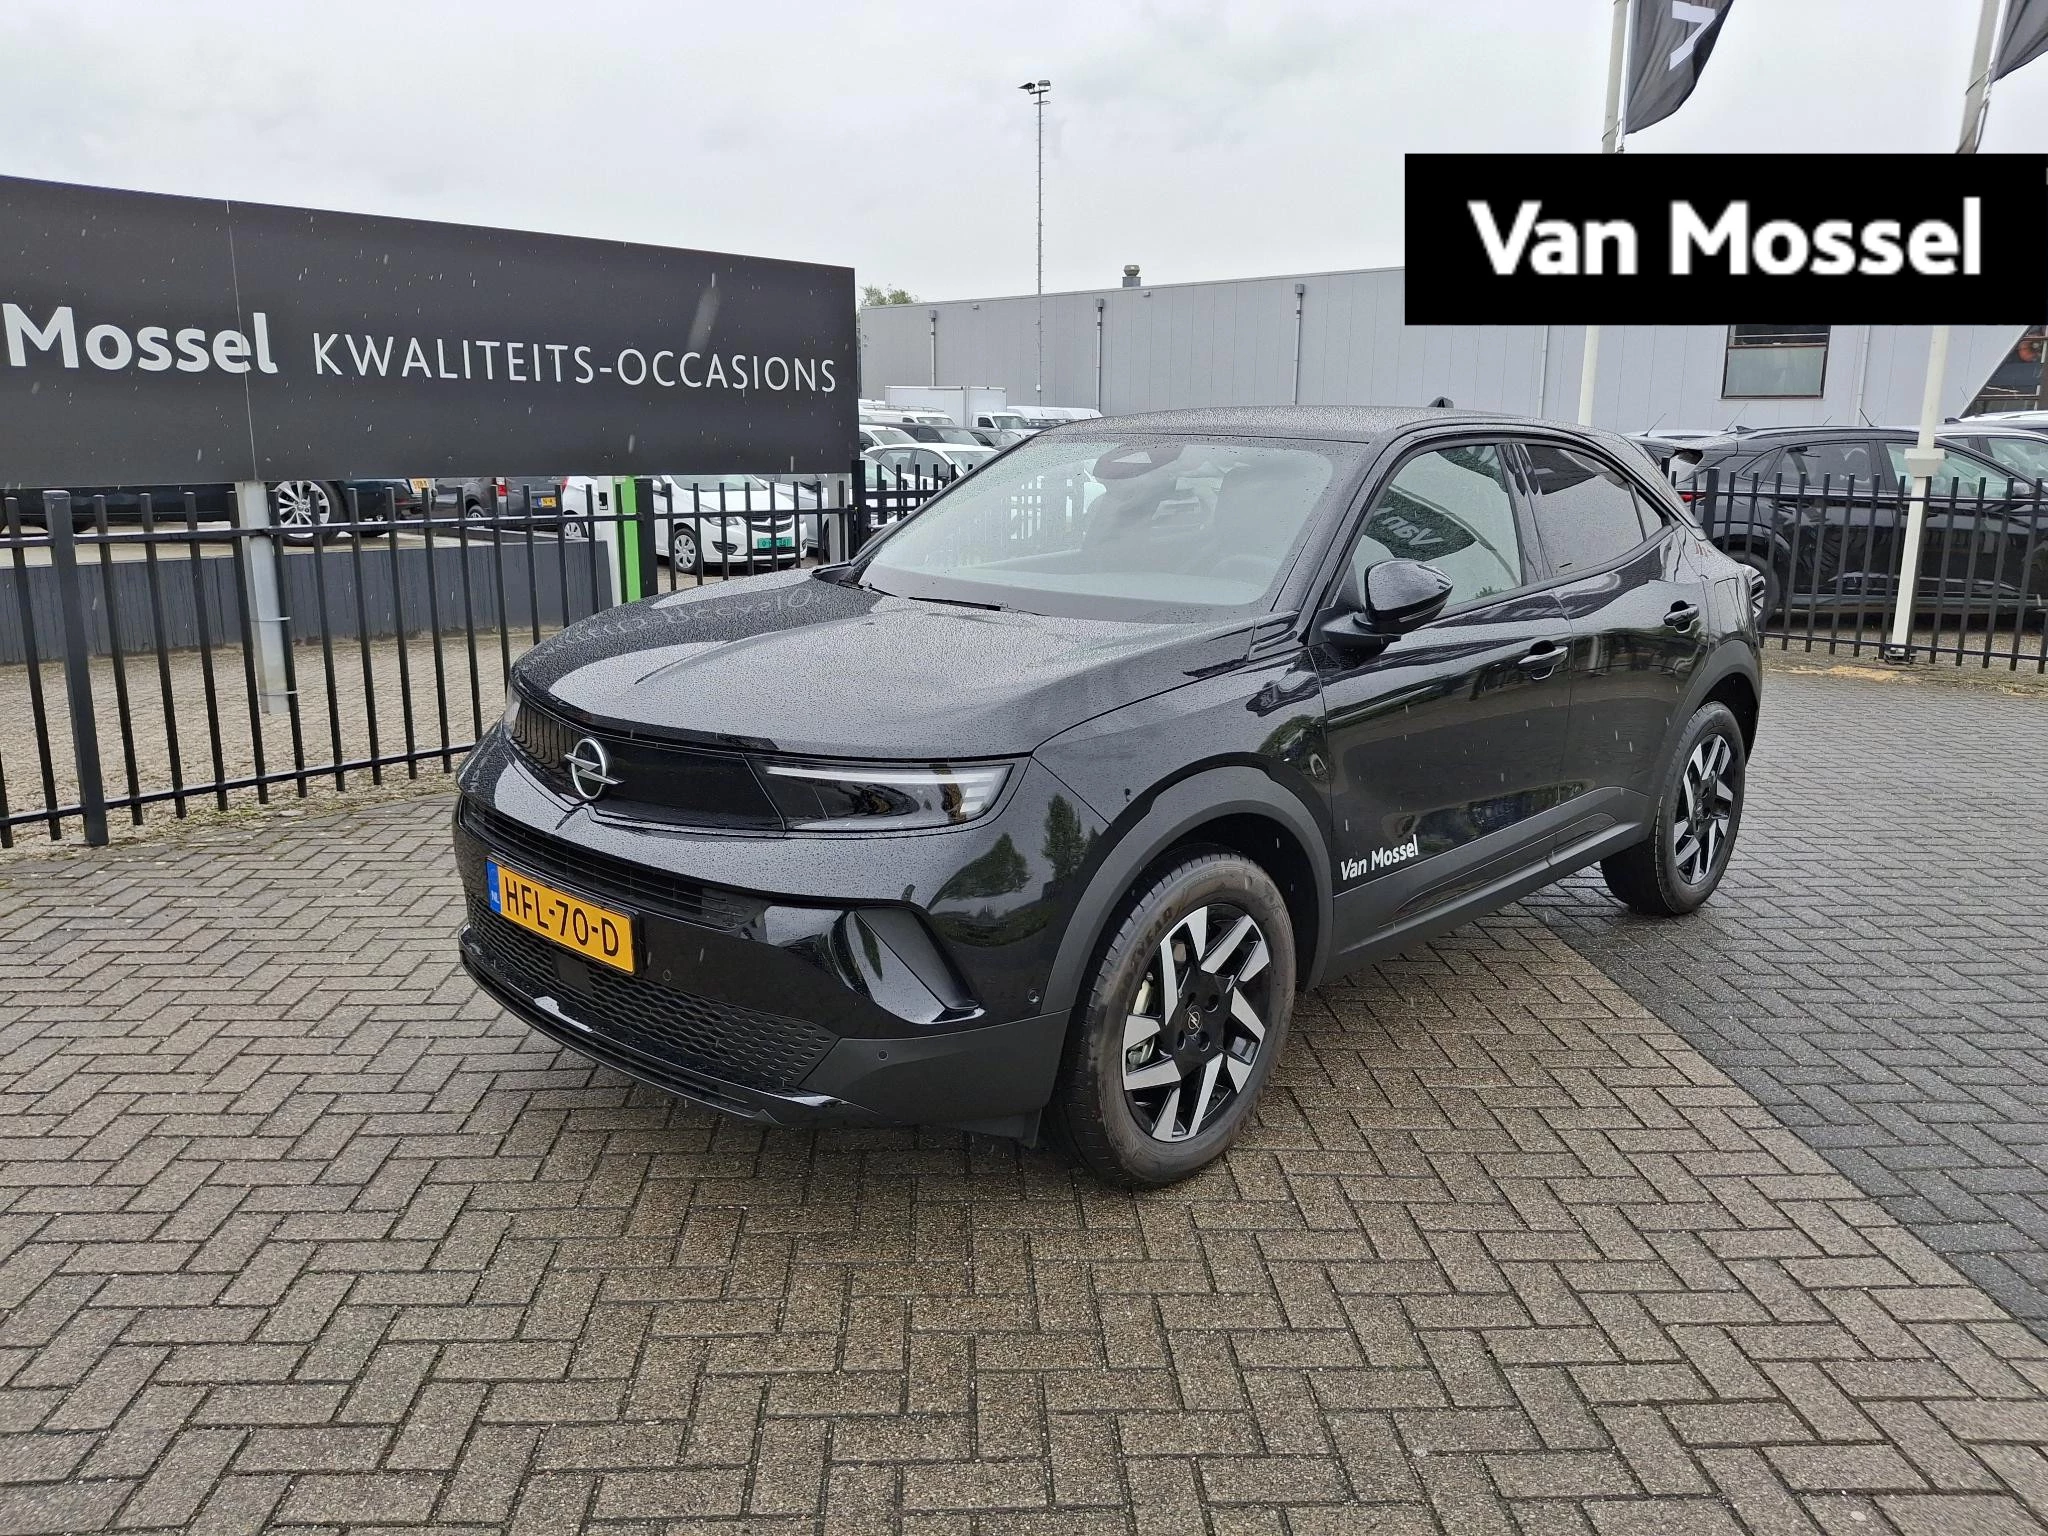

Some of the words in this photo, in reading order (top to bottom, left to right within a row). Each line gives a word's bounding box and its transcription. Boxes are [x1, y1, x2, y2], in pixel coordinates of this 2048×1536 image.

[2, 303, 279, 374] Mossel
[313, 332, 836, 393] KWALITEITS-OCCASIONS
[1340, 857, 1367, 880] Van
[1371, 833, 1419, 871] Mossel
[504, 876, 619, 957] HFL-70-D
